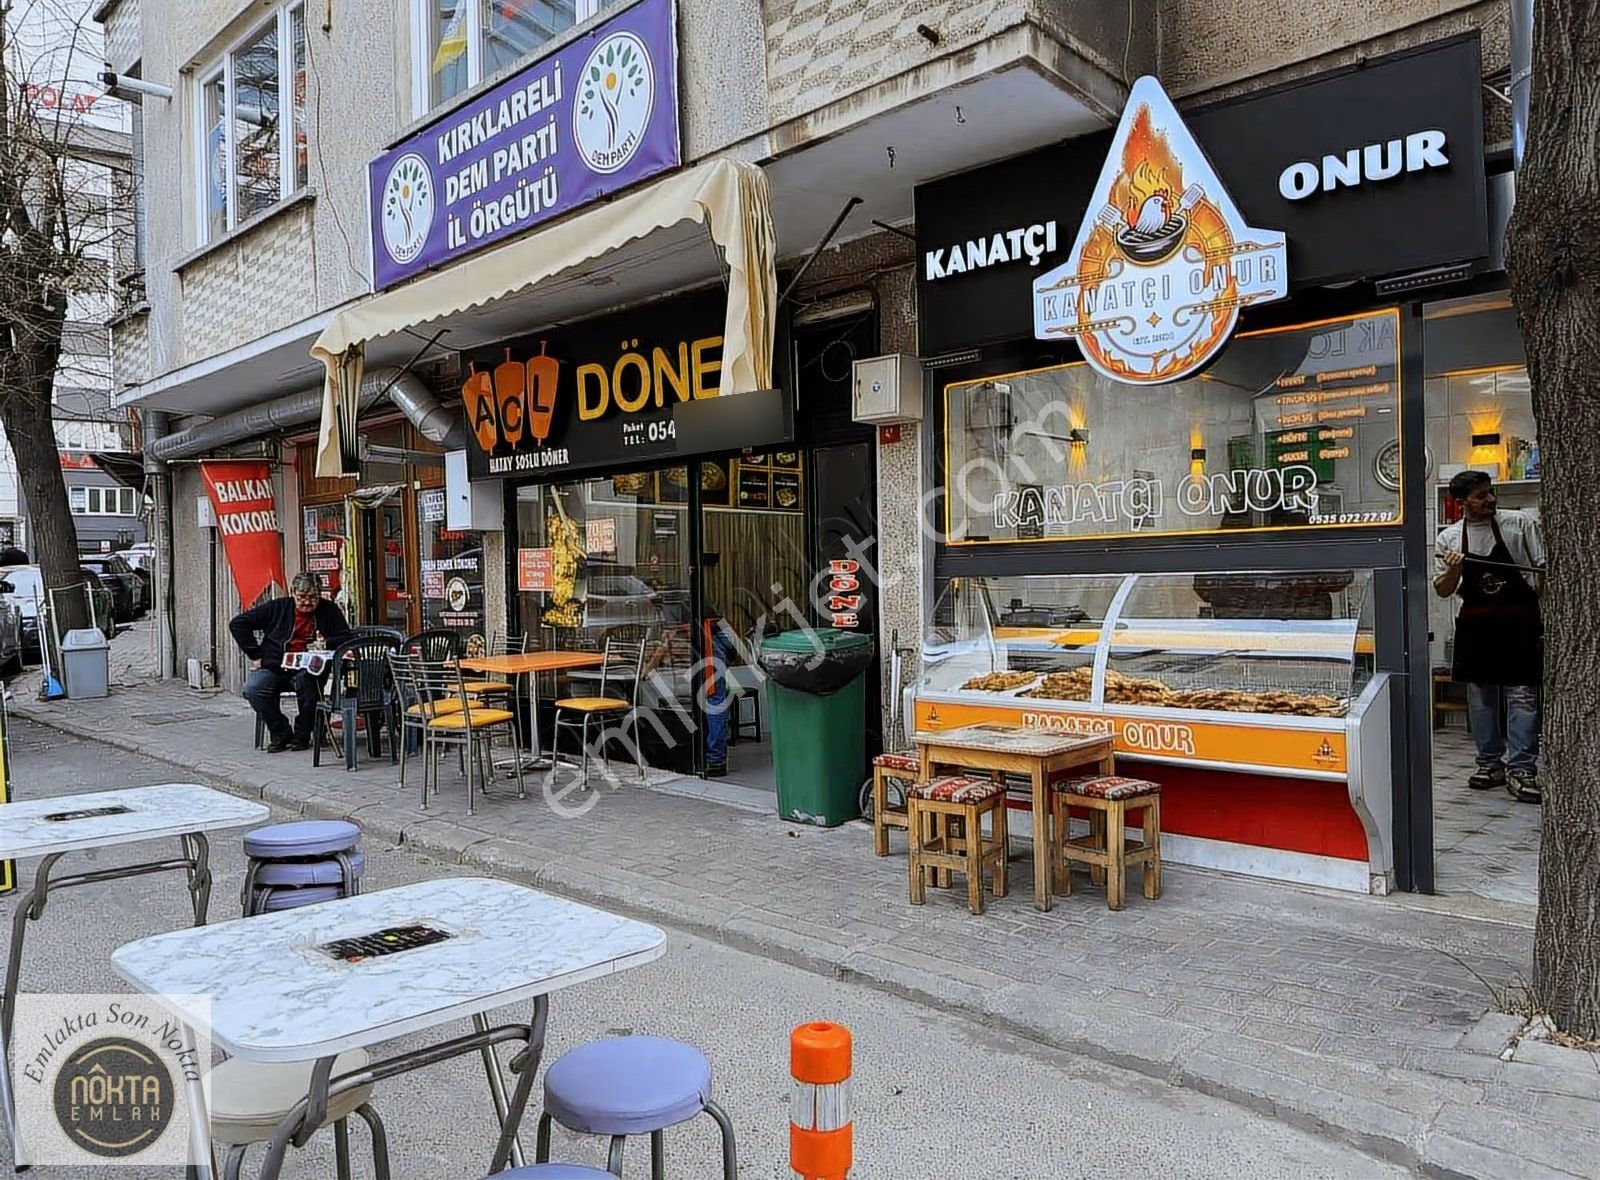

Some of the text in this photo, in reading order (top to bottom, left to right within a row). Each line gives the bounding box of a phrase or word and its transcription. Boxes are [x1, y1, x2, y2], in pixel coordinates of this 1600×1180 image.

[438, 60, 563, 165] KIRKLARELİ
[445, 115, 558, 206] DEM PARTİ
[447, 166, 558, 250] İL ÖRGÜTÜ
[925, 130, 1449, 282] KANATÇI ONUR
[1042, 255, 1277, 322] KANATÇI ONUR
[215, 476, 275, 503] BALKAN
[515, 452, 540, 470] SOSLU
[541, 447, 570, 467] DÖNER
[994, 464, 1319, 532] KANATÇI ONUR
[1123, 721, 1196, 756] ONUR
